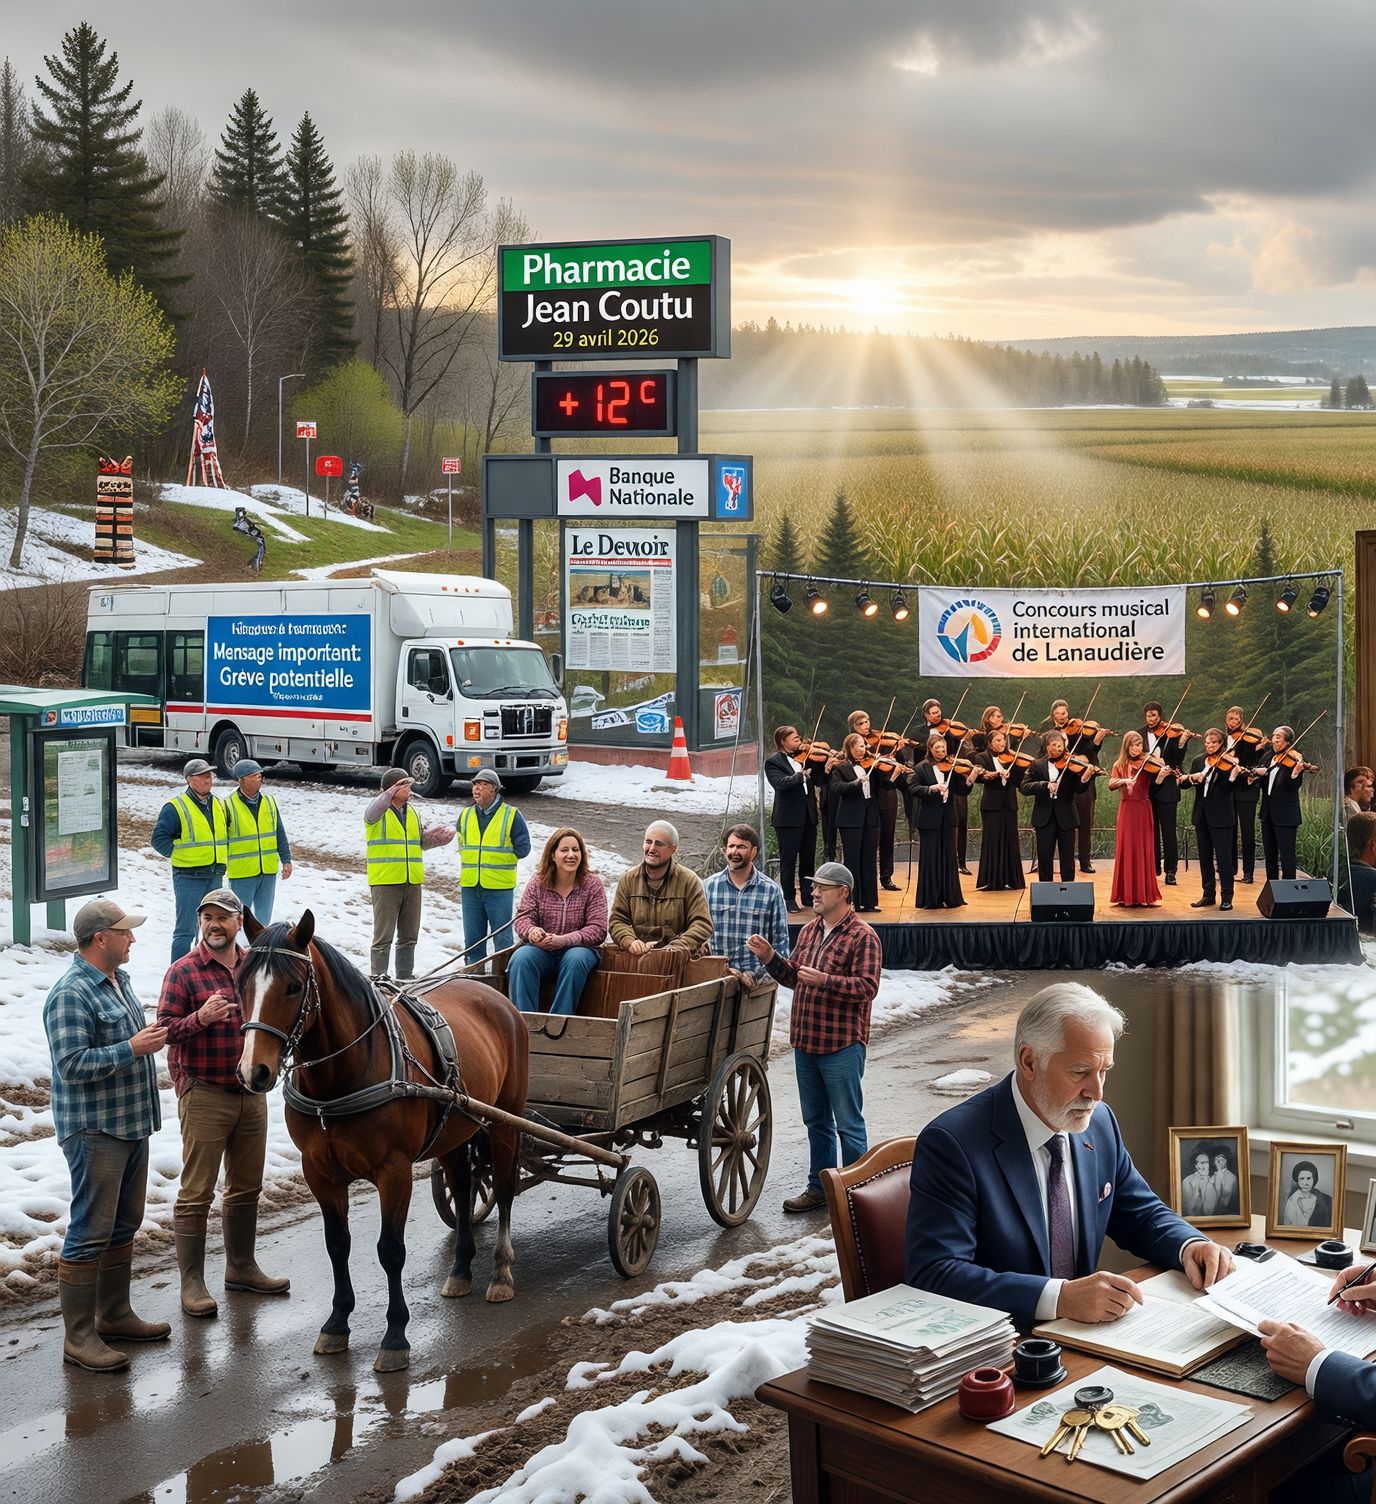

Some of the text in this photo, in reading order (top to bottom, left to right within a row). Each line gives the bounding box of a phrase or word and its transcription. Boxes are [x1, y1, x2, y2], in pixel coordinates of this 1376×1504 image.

[523, 249, 691, 285] Pharmacie
[521, 290, 693, 329] Jean Coutu
[553, 328, 659, 348] 29 avril 2026
[609, 467, 675, 487] Banque
[609, 488, 695, 506] Nationale
[571, 534, 594, 556] Le
[1012, 598, 1170, 618] Concours musical
[1013, 620, 1136, 639] international
[278, 641, 362, 666] important:
[1012, 641, 1165, 662] de Lanaudière
[269, 667, 354, 695] potentielle
